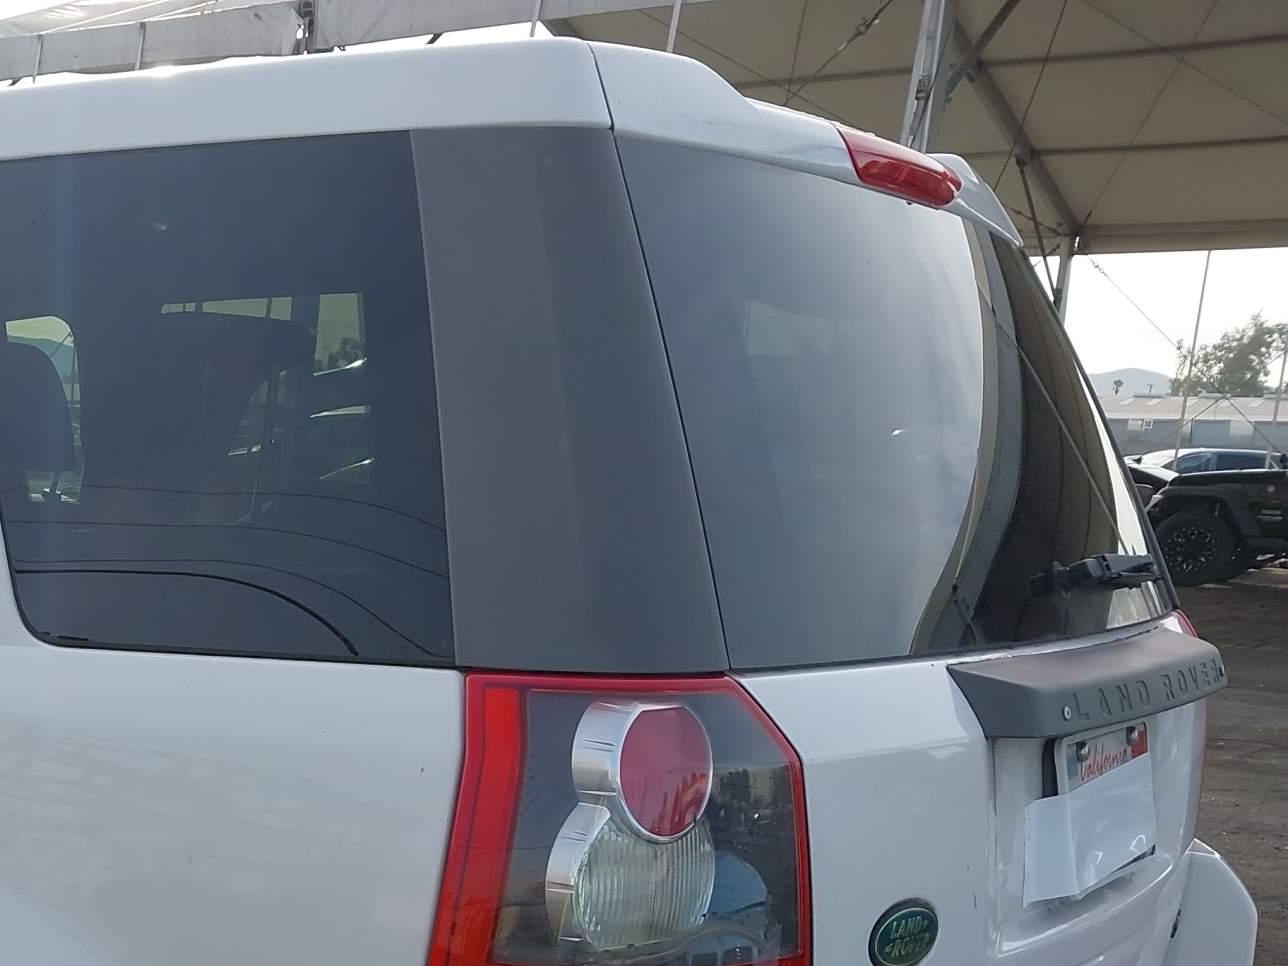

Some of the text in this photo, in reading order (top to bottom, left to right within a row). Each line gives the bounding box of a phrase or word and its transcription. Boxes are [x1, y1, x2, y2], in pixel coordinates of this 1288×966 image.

[1071, 658, 1222, 721] LAND ROVER
[889, 914, 923, 939] LAND
